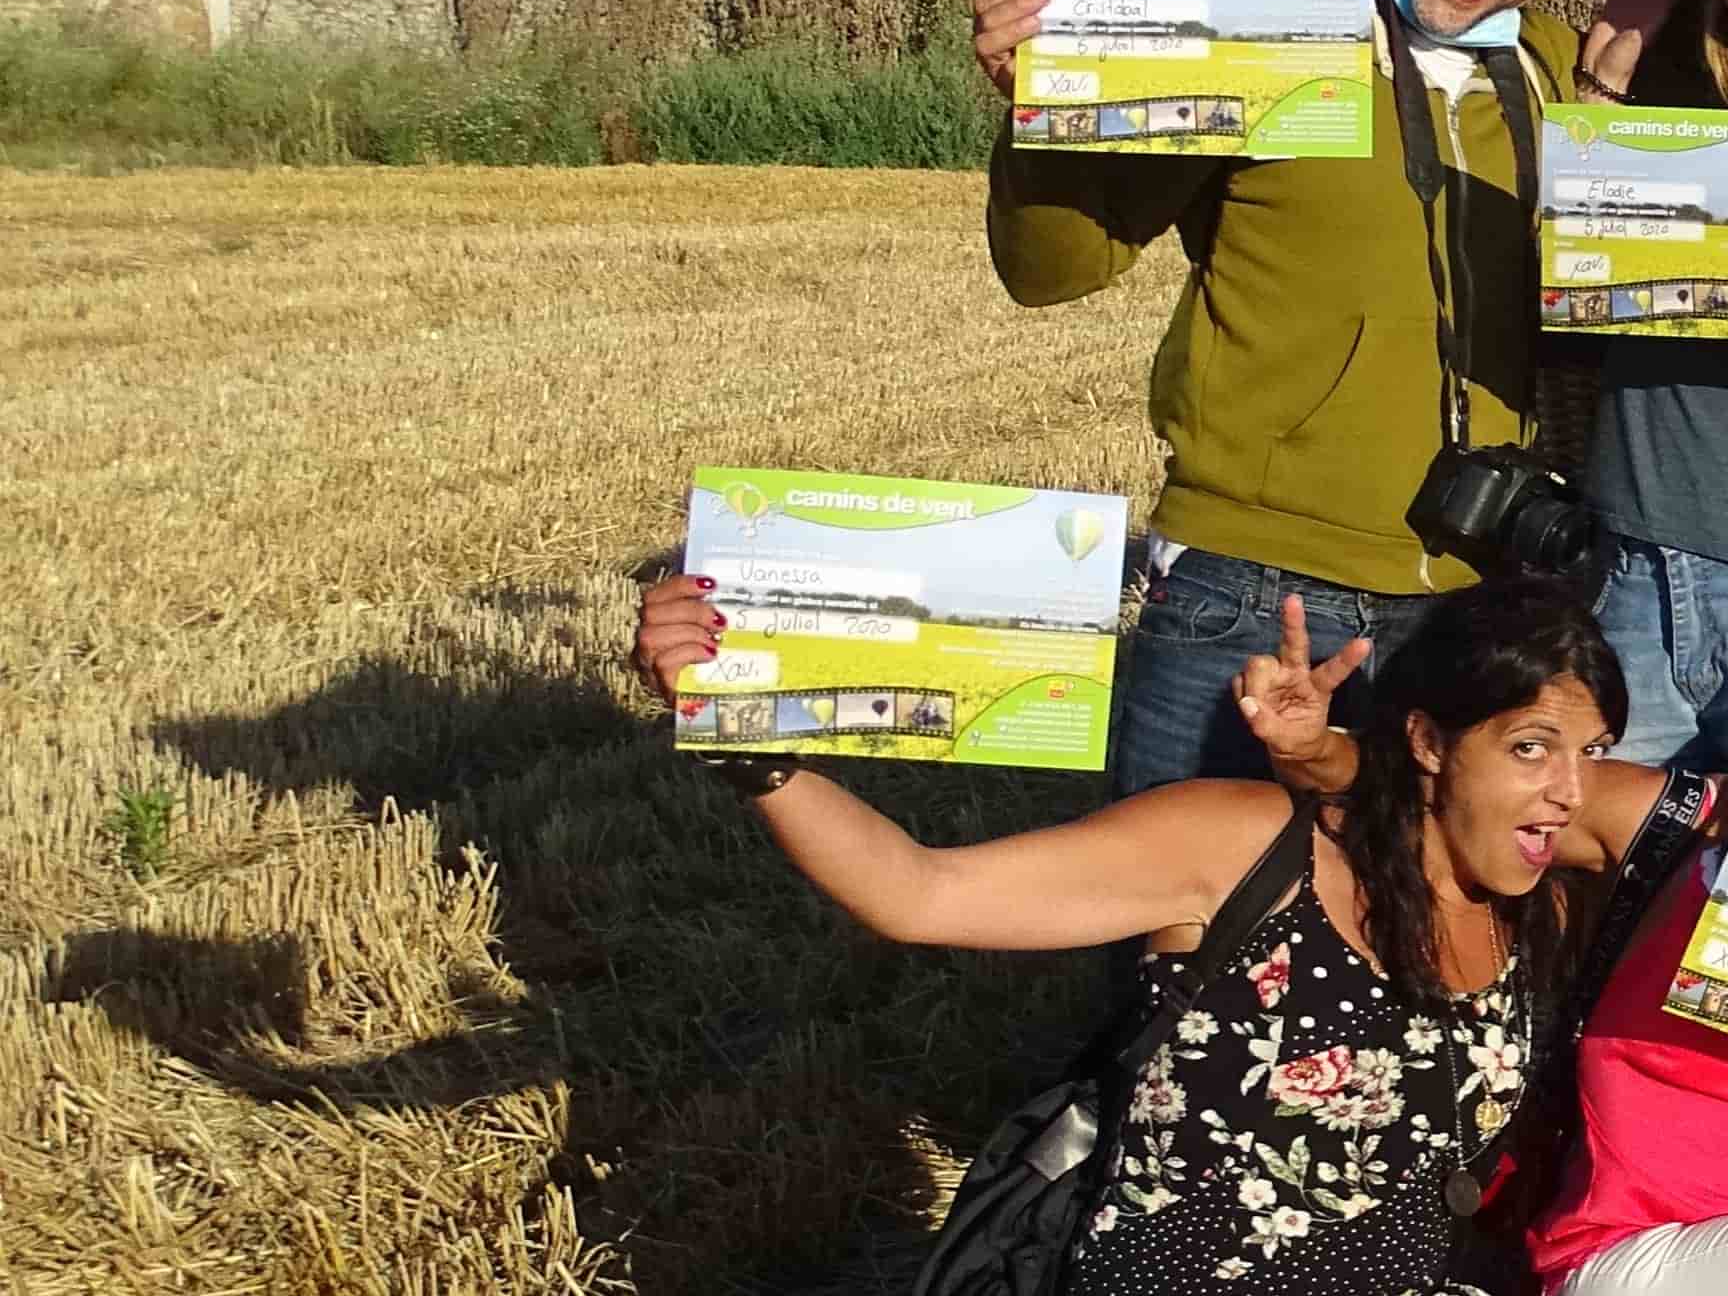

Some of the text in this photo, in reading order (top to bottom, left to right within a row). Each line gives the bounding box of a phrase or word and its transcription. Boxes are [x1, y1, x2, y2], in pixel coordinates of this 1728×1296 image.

[1608, 119, 1673, 138] camins
[1676, 122, 1699, 138] de
[1587, 177, 1636, 201] Elodie
[1584, 219, 1594, 236] 5
[784, 487, 977, 521] camins de vent
[739, 560, 824, 585] Vanessa
